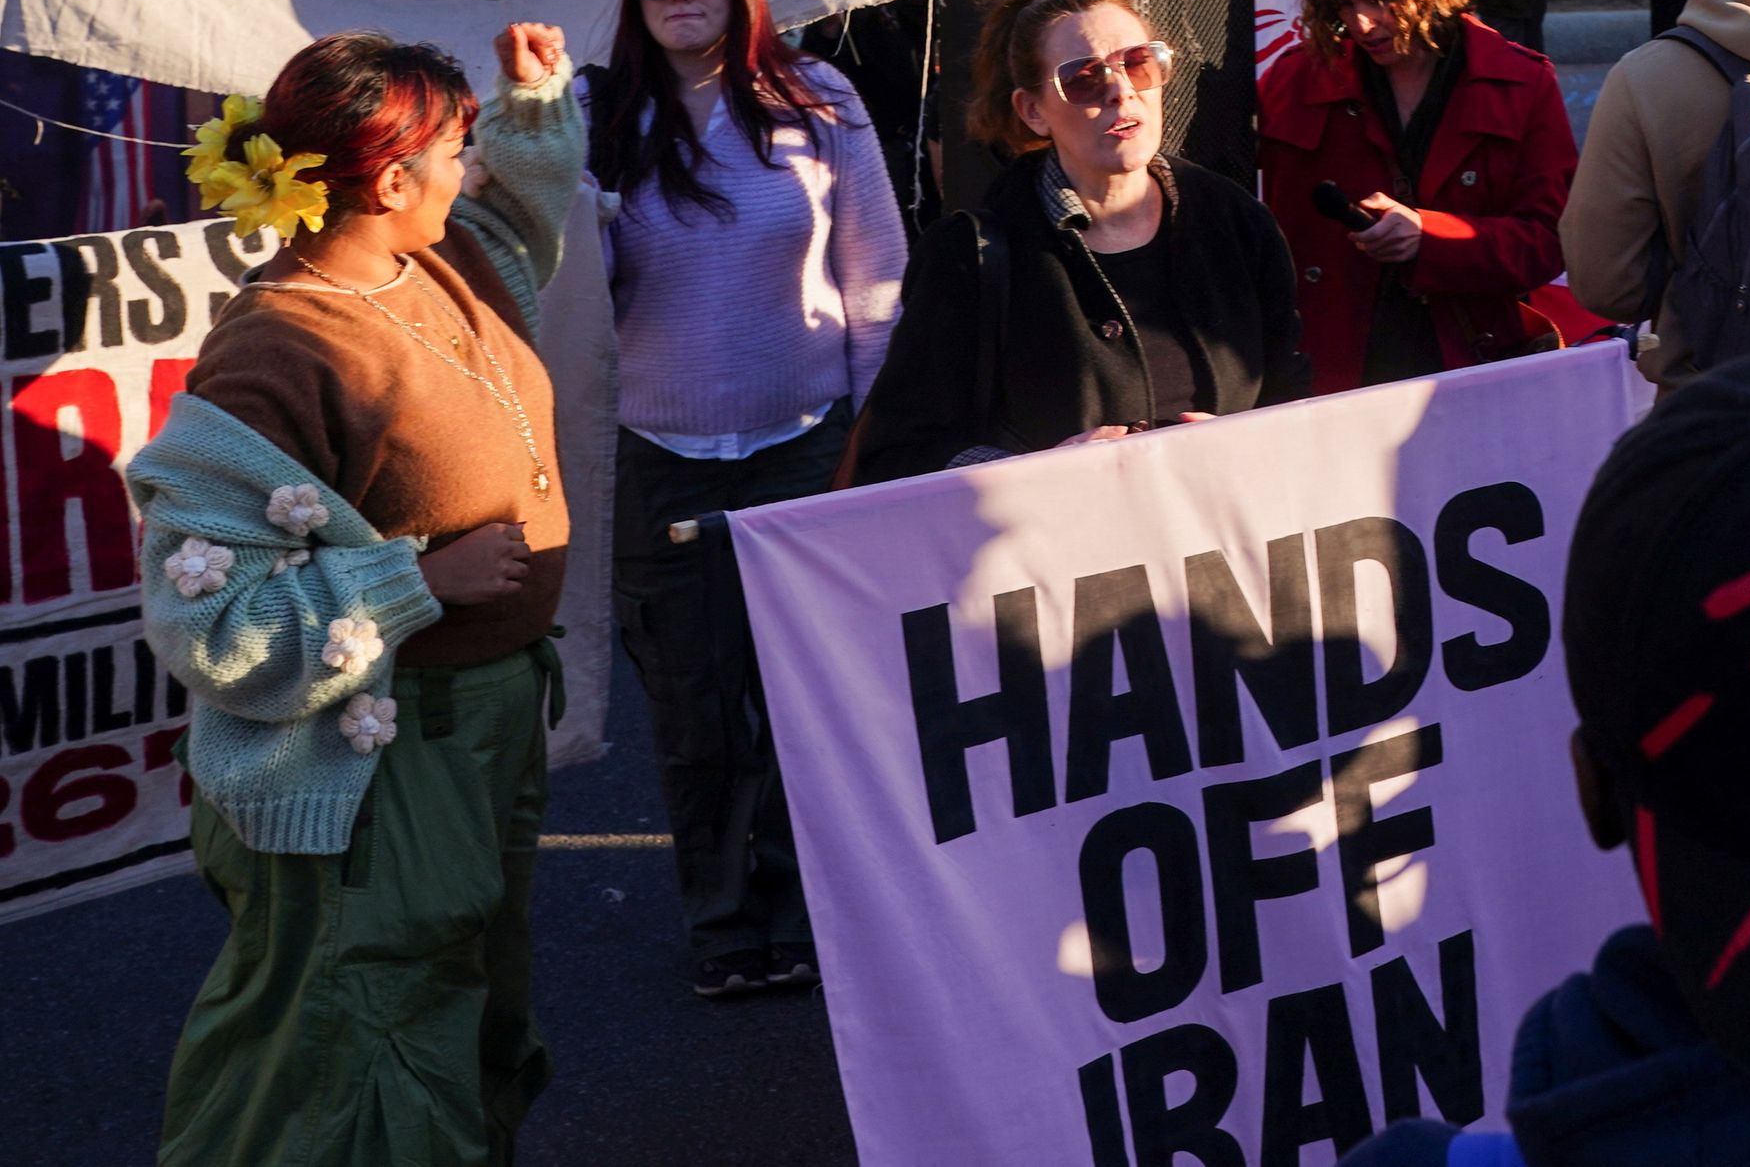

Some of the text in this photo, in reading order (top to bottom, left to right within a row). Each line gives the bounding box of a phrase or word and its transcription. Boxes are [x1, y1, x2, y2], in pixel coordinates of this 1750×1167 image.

[901, 481, 1551, 846] HANDS
[1078, 723, 1442, 1025] OFF
[1078, 930, 1485, 1167] IRAN
